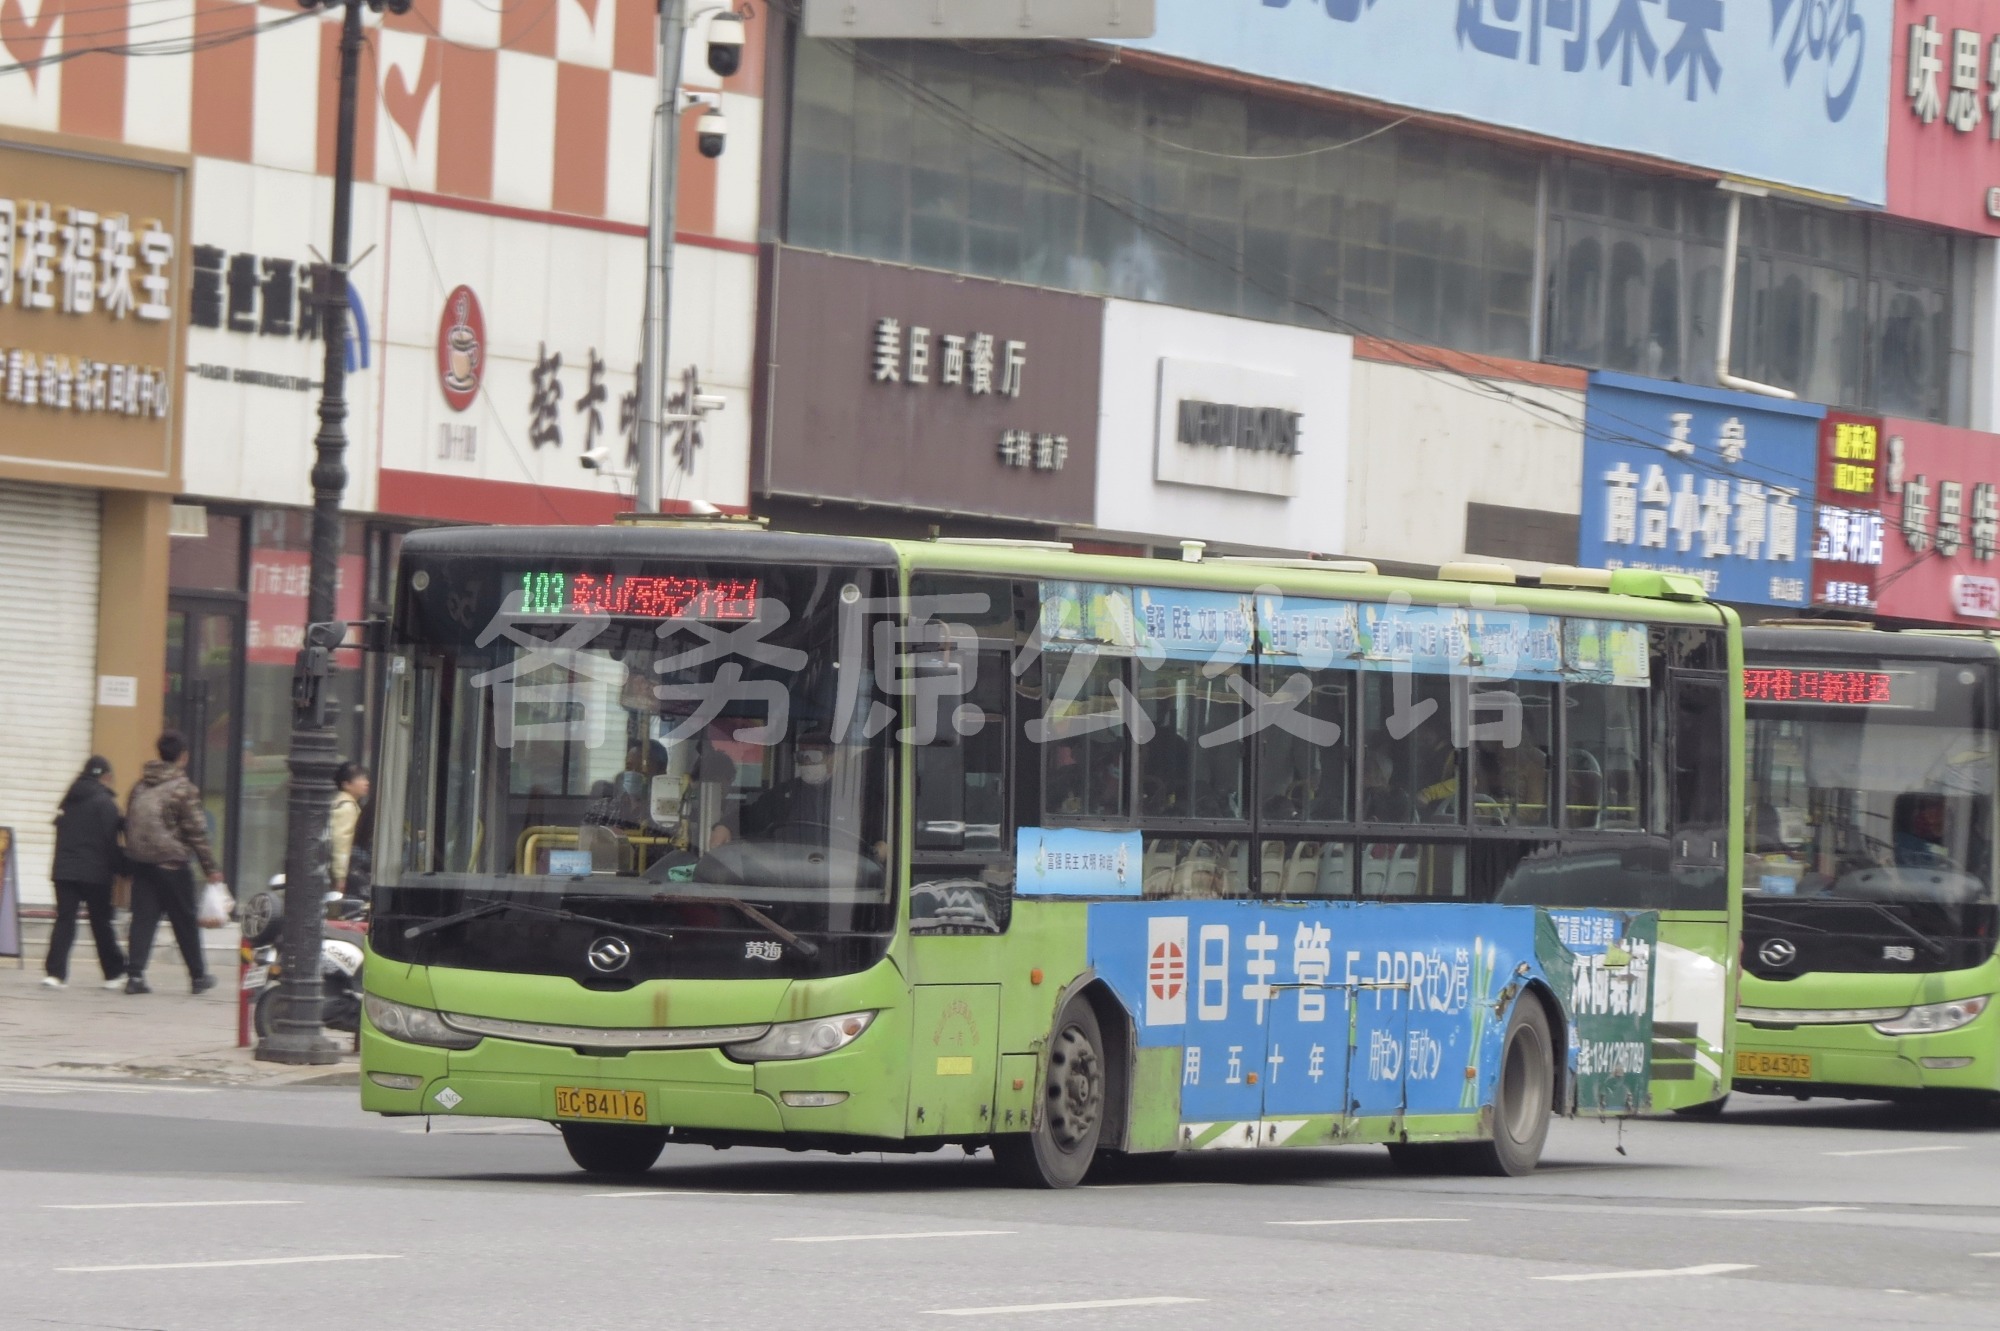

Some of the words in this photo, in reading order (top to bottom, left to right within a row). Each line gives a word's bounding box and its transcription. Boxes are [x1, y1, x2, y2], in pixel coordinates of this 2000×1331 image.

[873, 318, 1026, 397] 美臣西餐厅
[521, 572, 565, 613] 103
[1146, 604, 1166, 640] 富强
[1172, 606, 1191, 641] 民主
[1198, 608, 1217, 643] 文明
[1272, 613, 1287, 647] 自由
[1292, 613, 1308, 649] 平等
[1065, 852, 1079, 870] 民主
[745, 941, 782, 961] 黄海
[1882, 946, 1915, 962] 黄海
[1198, 920, 1332, 1025] 日丰管
[1183, 1042, 1326, 1086] 用五十年
[440, 1093, 458, 1103] LNG
